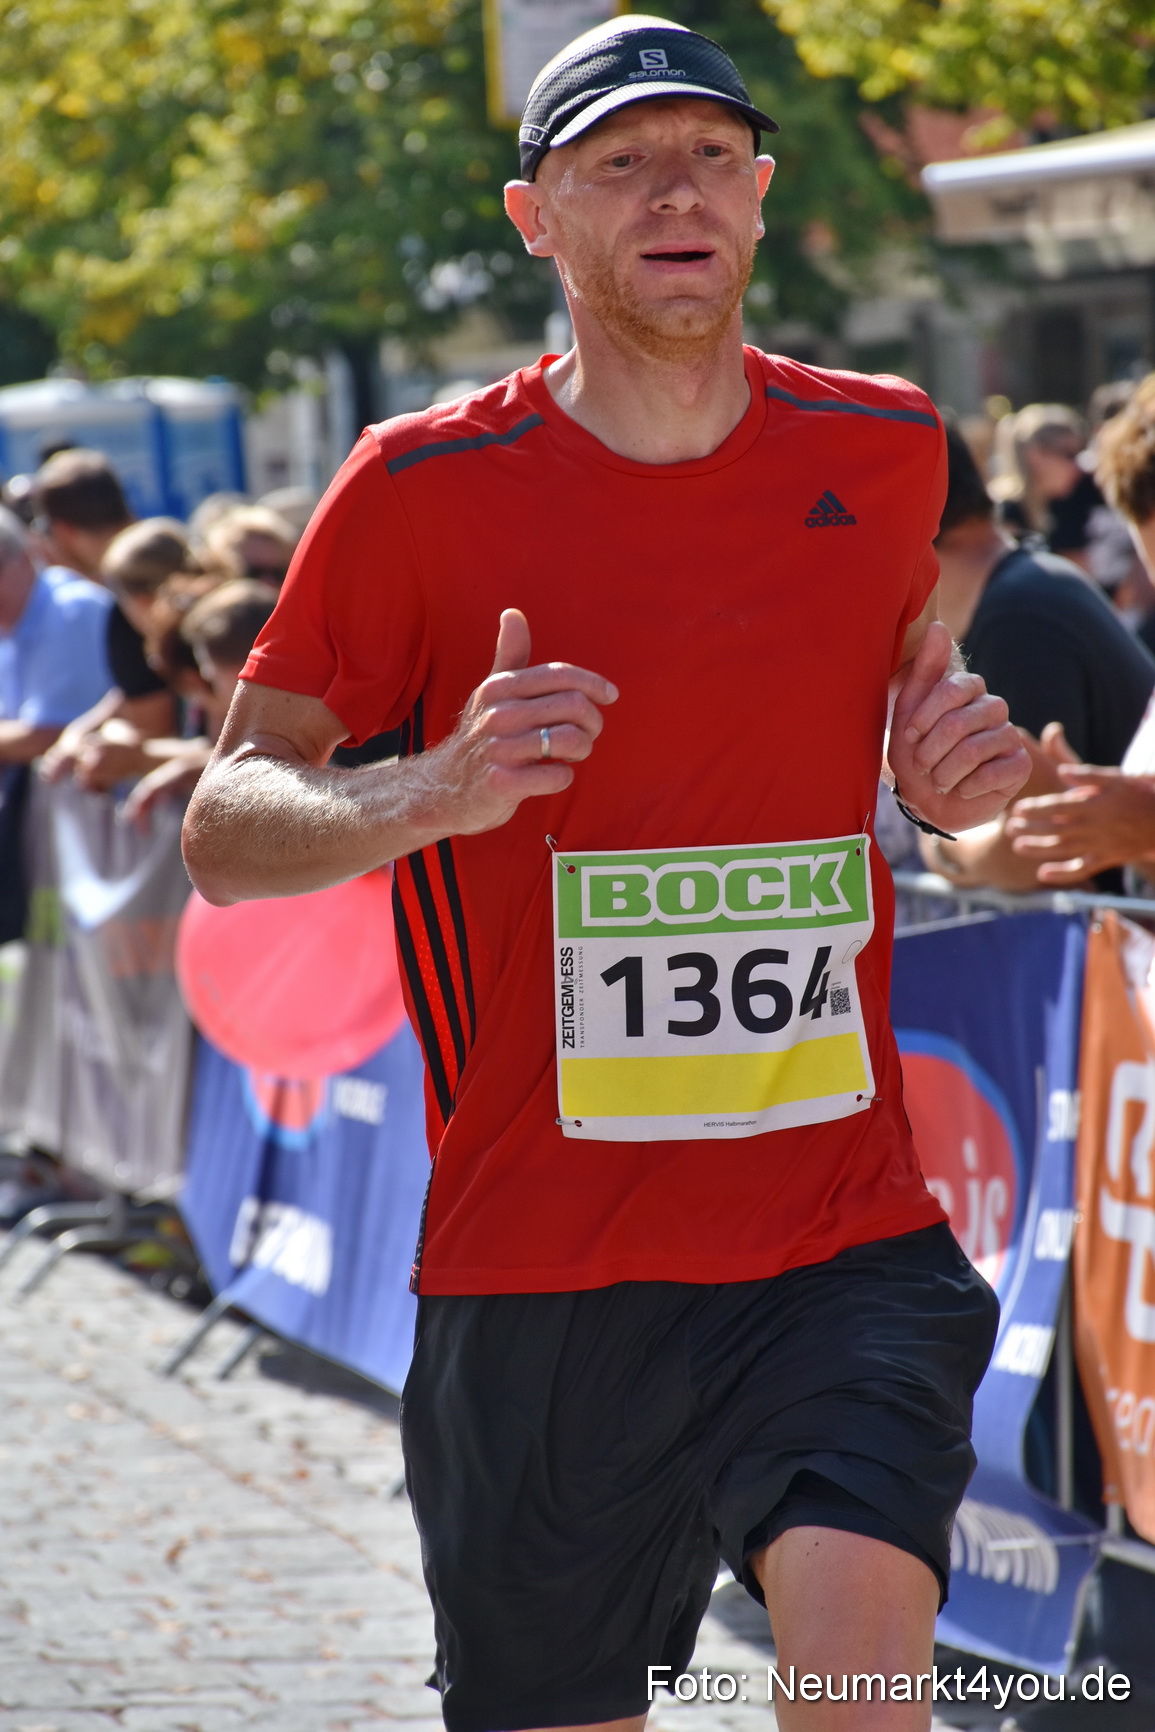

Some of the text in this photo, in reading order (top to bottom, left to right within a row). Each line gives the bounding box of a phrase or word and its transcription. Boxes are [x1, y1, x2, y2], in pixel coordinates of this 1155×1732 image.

[804, 513, 857, 528] adidas
[586, 855, 847, 922] BOCK
[600, 946, 833, 1038] 1364
